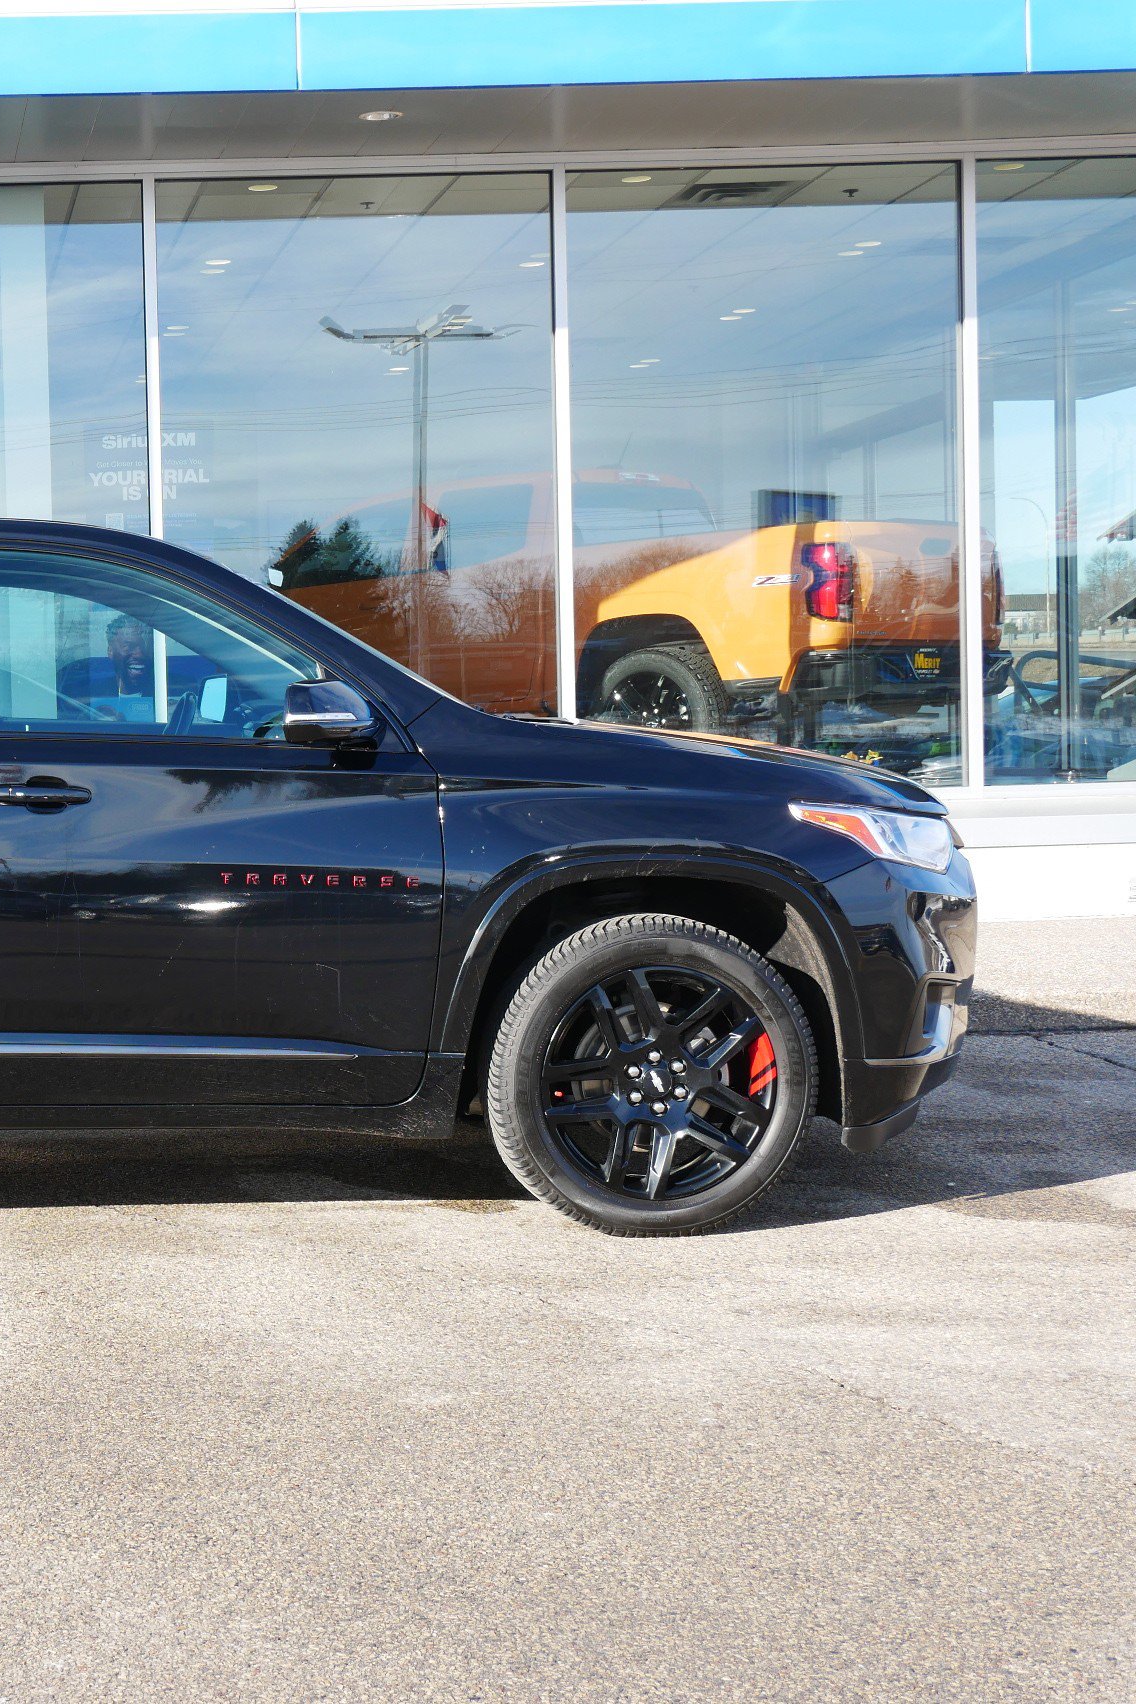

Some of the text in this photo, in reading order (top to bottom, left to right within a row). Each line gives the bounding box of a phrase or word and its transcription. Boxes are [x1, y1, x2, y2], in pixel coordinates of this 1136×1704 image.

[102, 431, 196, 450] SiriuXM
[89, 468, 210, 487] YOUR RIAL
[122, 485, 142, 501] IS
[914, 653, 941, 669] MERIT
[220, 872, 420, 888] TRAVERSE
